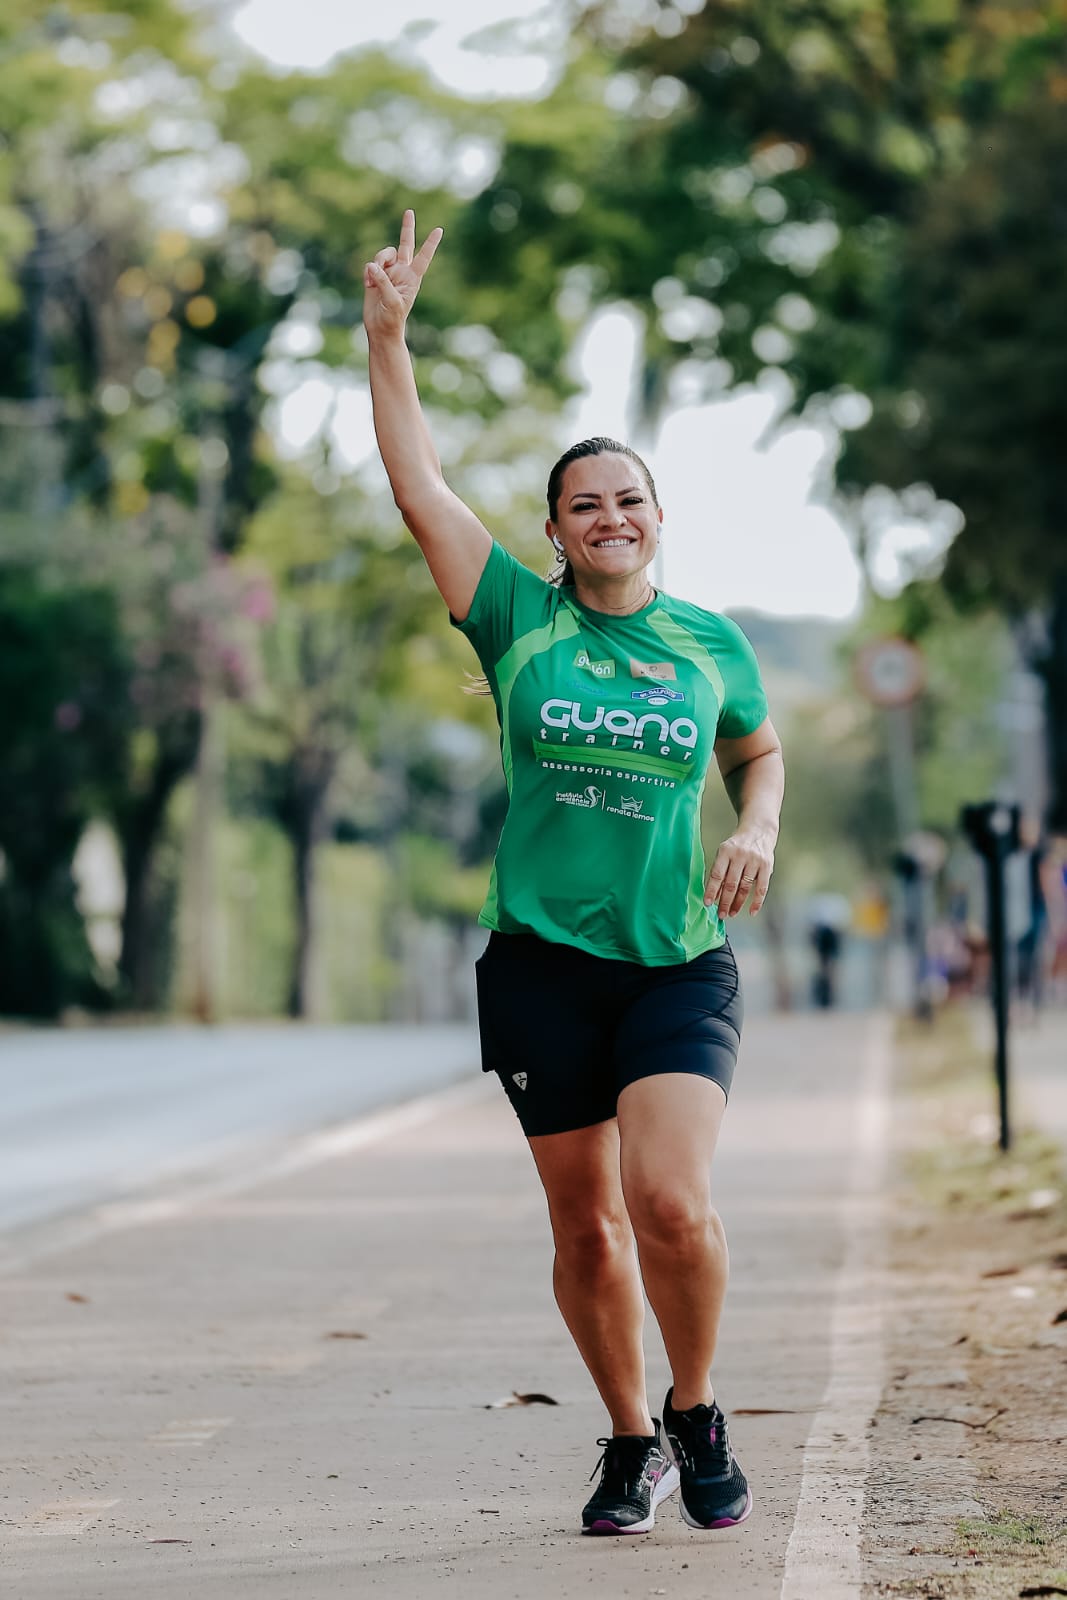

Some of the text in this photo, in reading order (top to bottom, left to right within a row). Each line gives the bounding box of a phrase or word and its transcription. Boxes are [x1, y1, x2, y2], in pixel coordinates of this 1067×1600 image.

[540, 727, 692, 761] trainer
[542, 761, 676, 788] assessoria esportiva
